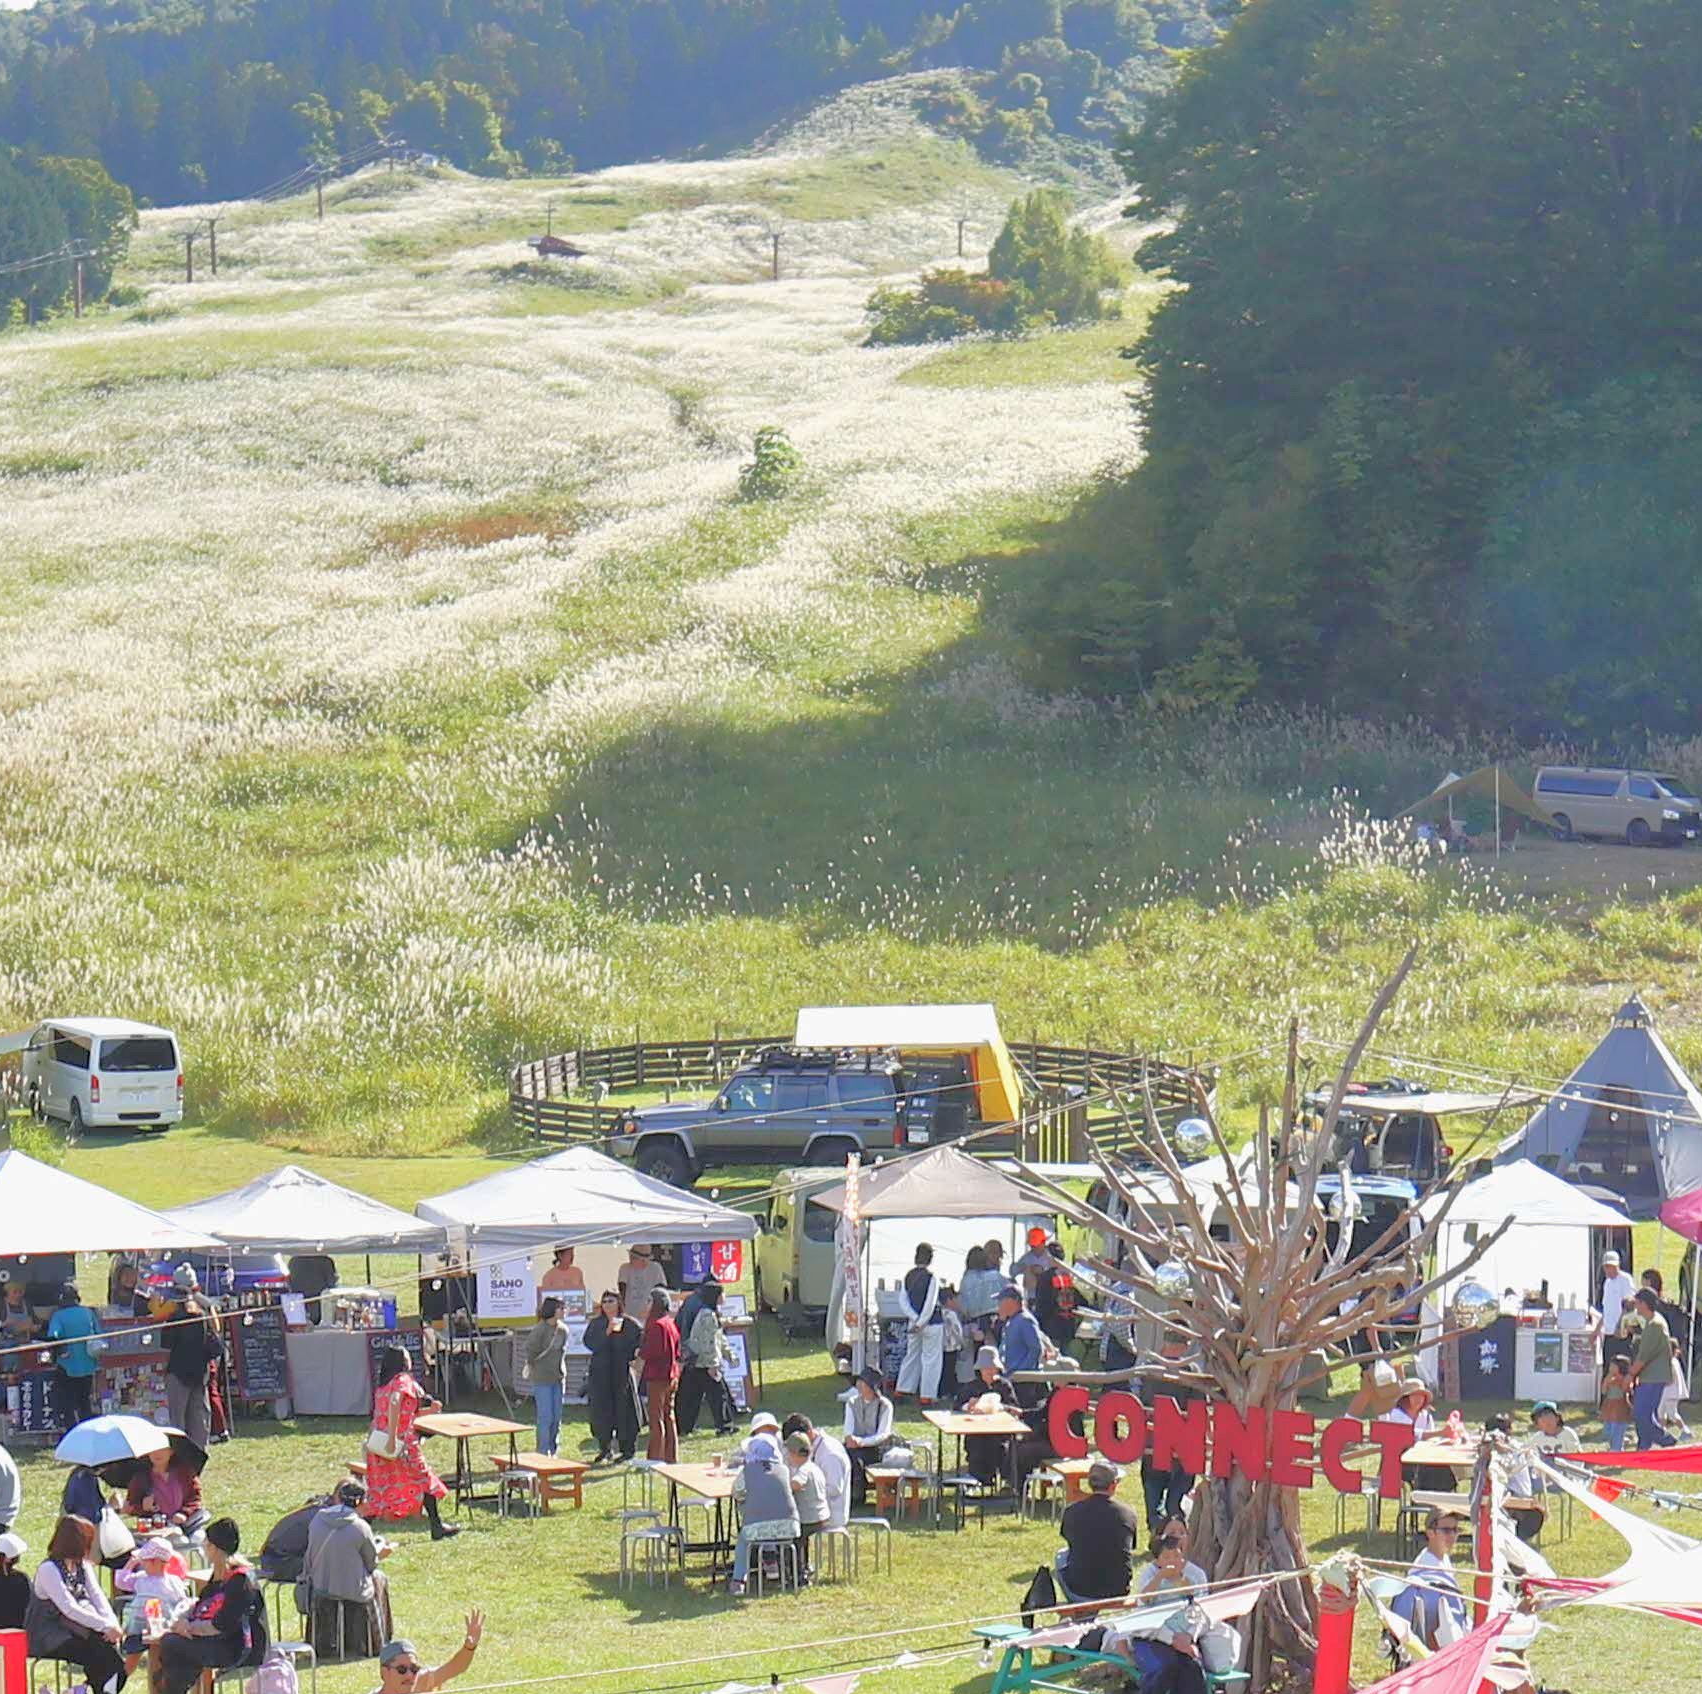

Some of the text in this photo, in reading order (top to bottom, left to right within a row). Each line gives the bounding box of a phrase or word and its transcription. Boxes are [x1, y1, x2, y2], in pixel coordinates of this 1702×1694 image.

[715, 1242, 737, 1281] 甘酒
[490, 1278, 523, 1289] SANO
[490, 1289, 515, 1299] RICE
[1047, 1384, 1416, 1500] CONNECT
